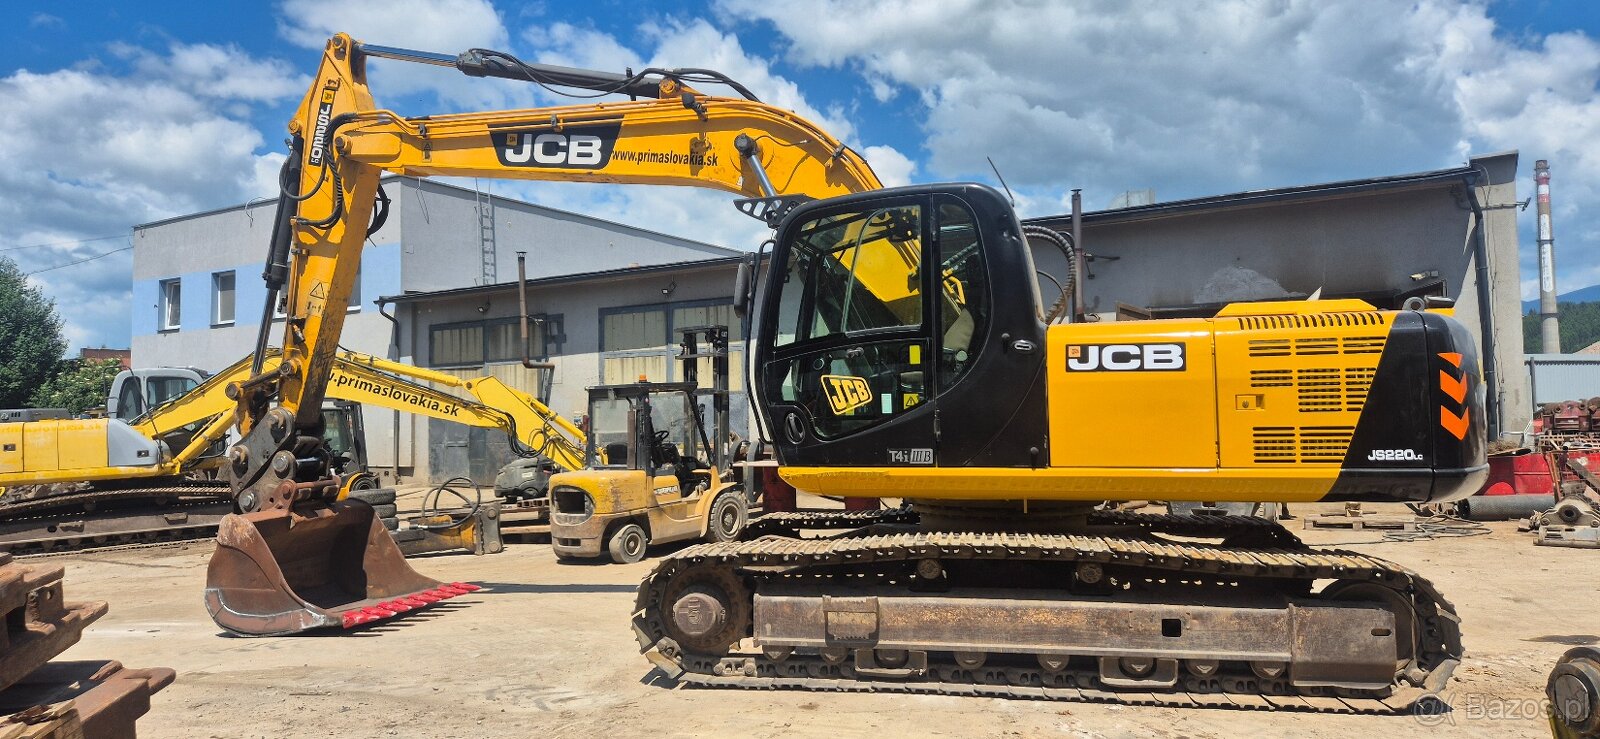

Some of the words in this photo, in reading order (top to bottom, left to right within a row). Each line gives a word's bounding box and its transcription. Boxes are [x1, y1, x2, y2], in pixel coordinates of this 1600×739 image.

[505, 134, 602, 165] JCB
[612, 149, 718, 167] www.primaslovakia.sk
[1068, 344, 1184, 371] JCB
[328, 372, 460, 417] .primaslovakia.sk
[830, 379, 869, 410] JCB
